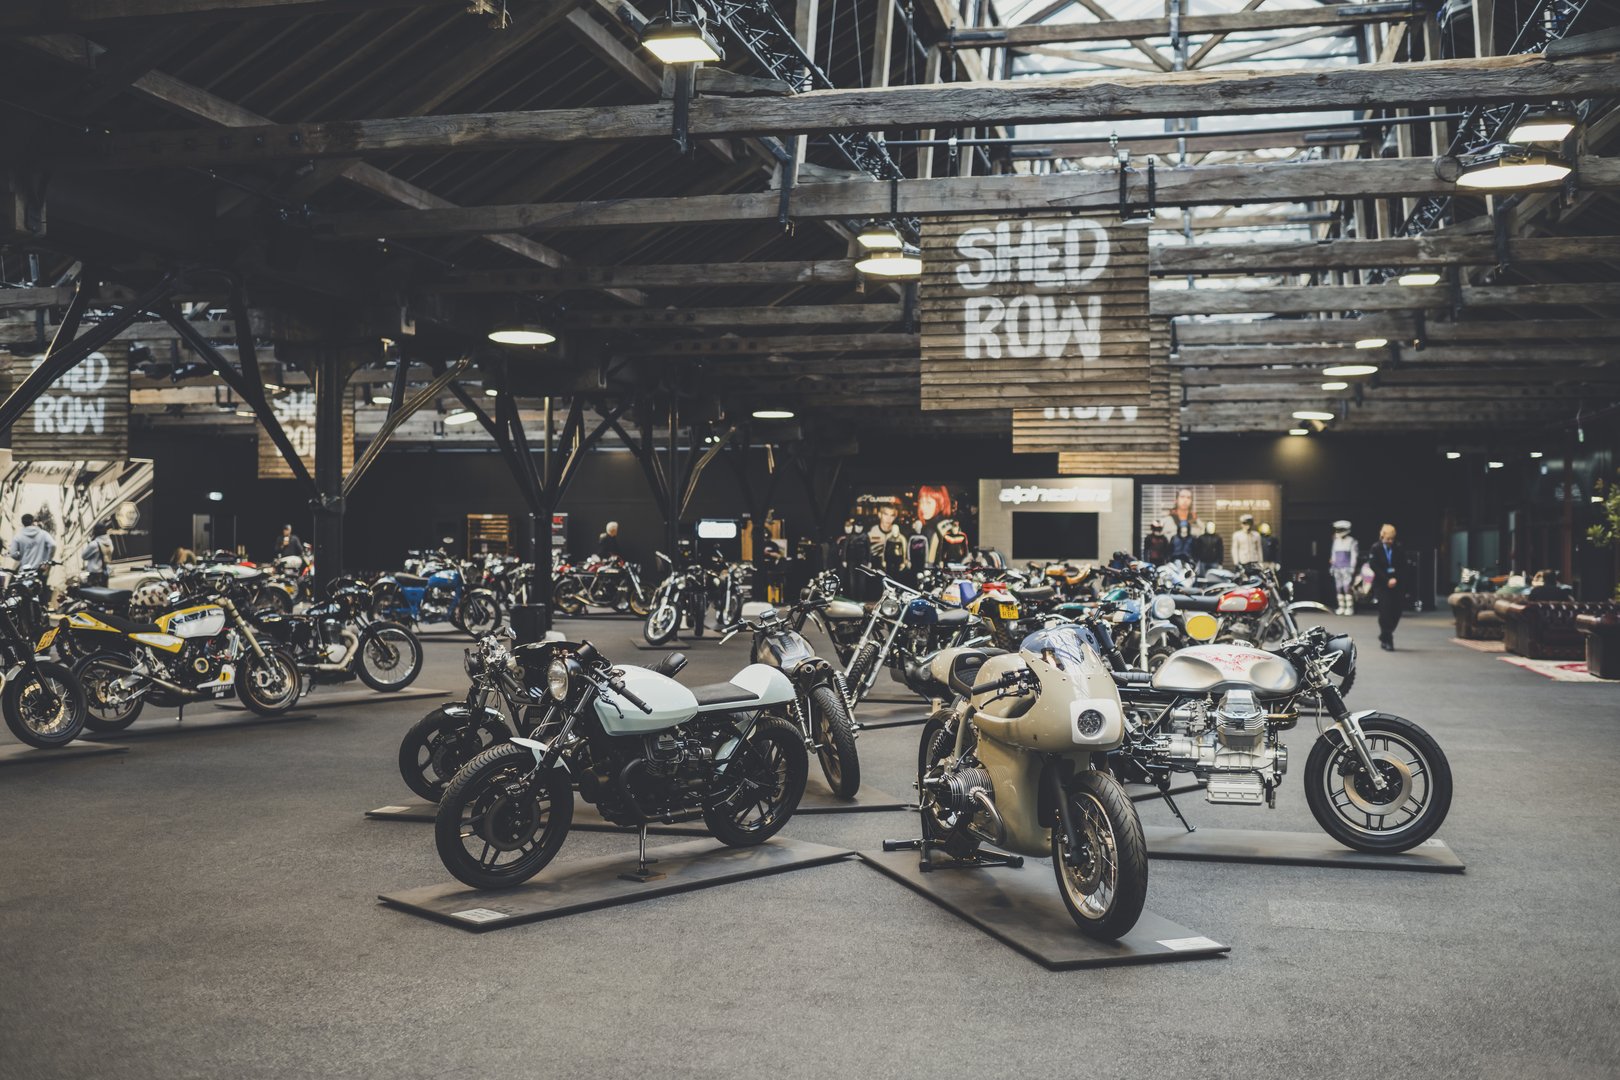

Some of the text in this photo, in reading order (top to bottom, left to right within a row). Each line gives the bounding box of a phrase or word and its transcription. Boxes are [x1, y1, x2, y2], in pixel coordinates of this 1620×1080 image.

[956, 219, 1110, 289] SHED
[965, 295, 1102, 361] ROW
[34, 395, 105, 434] ROW
